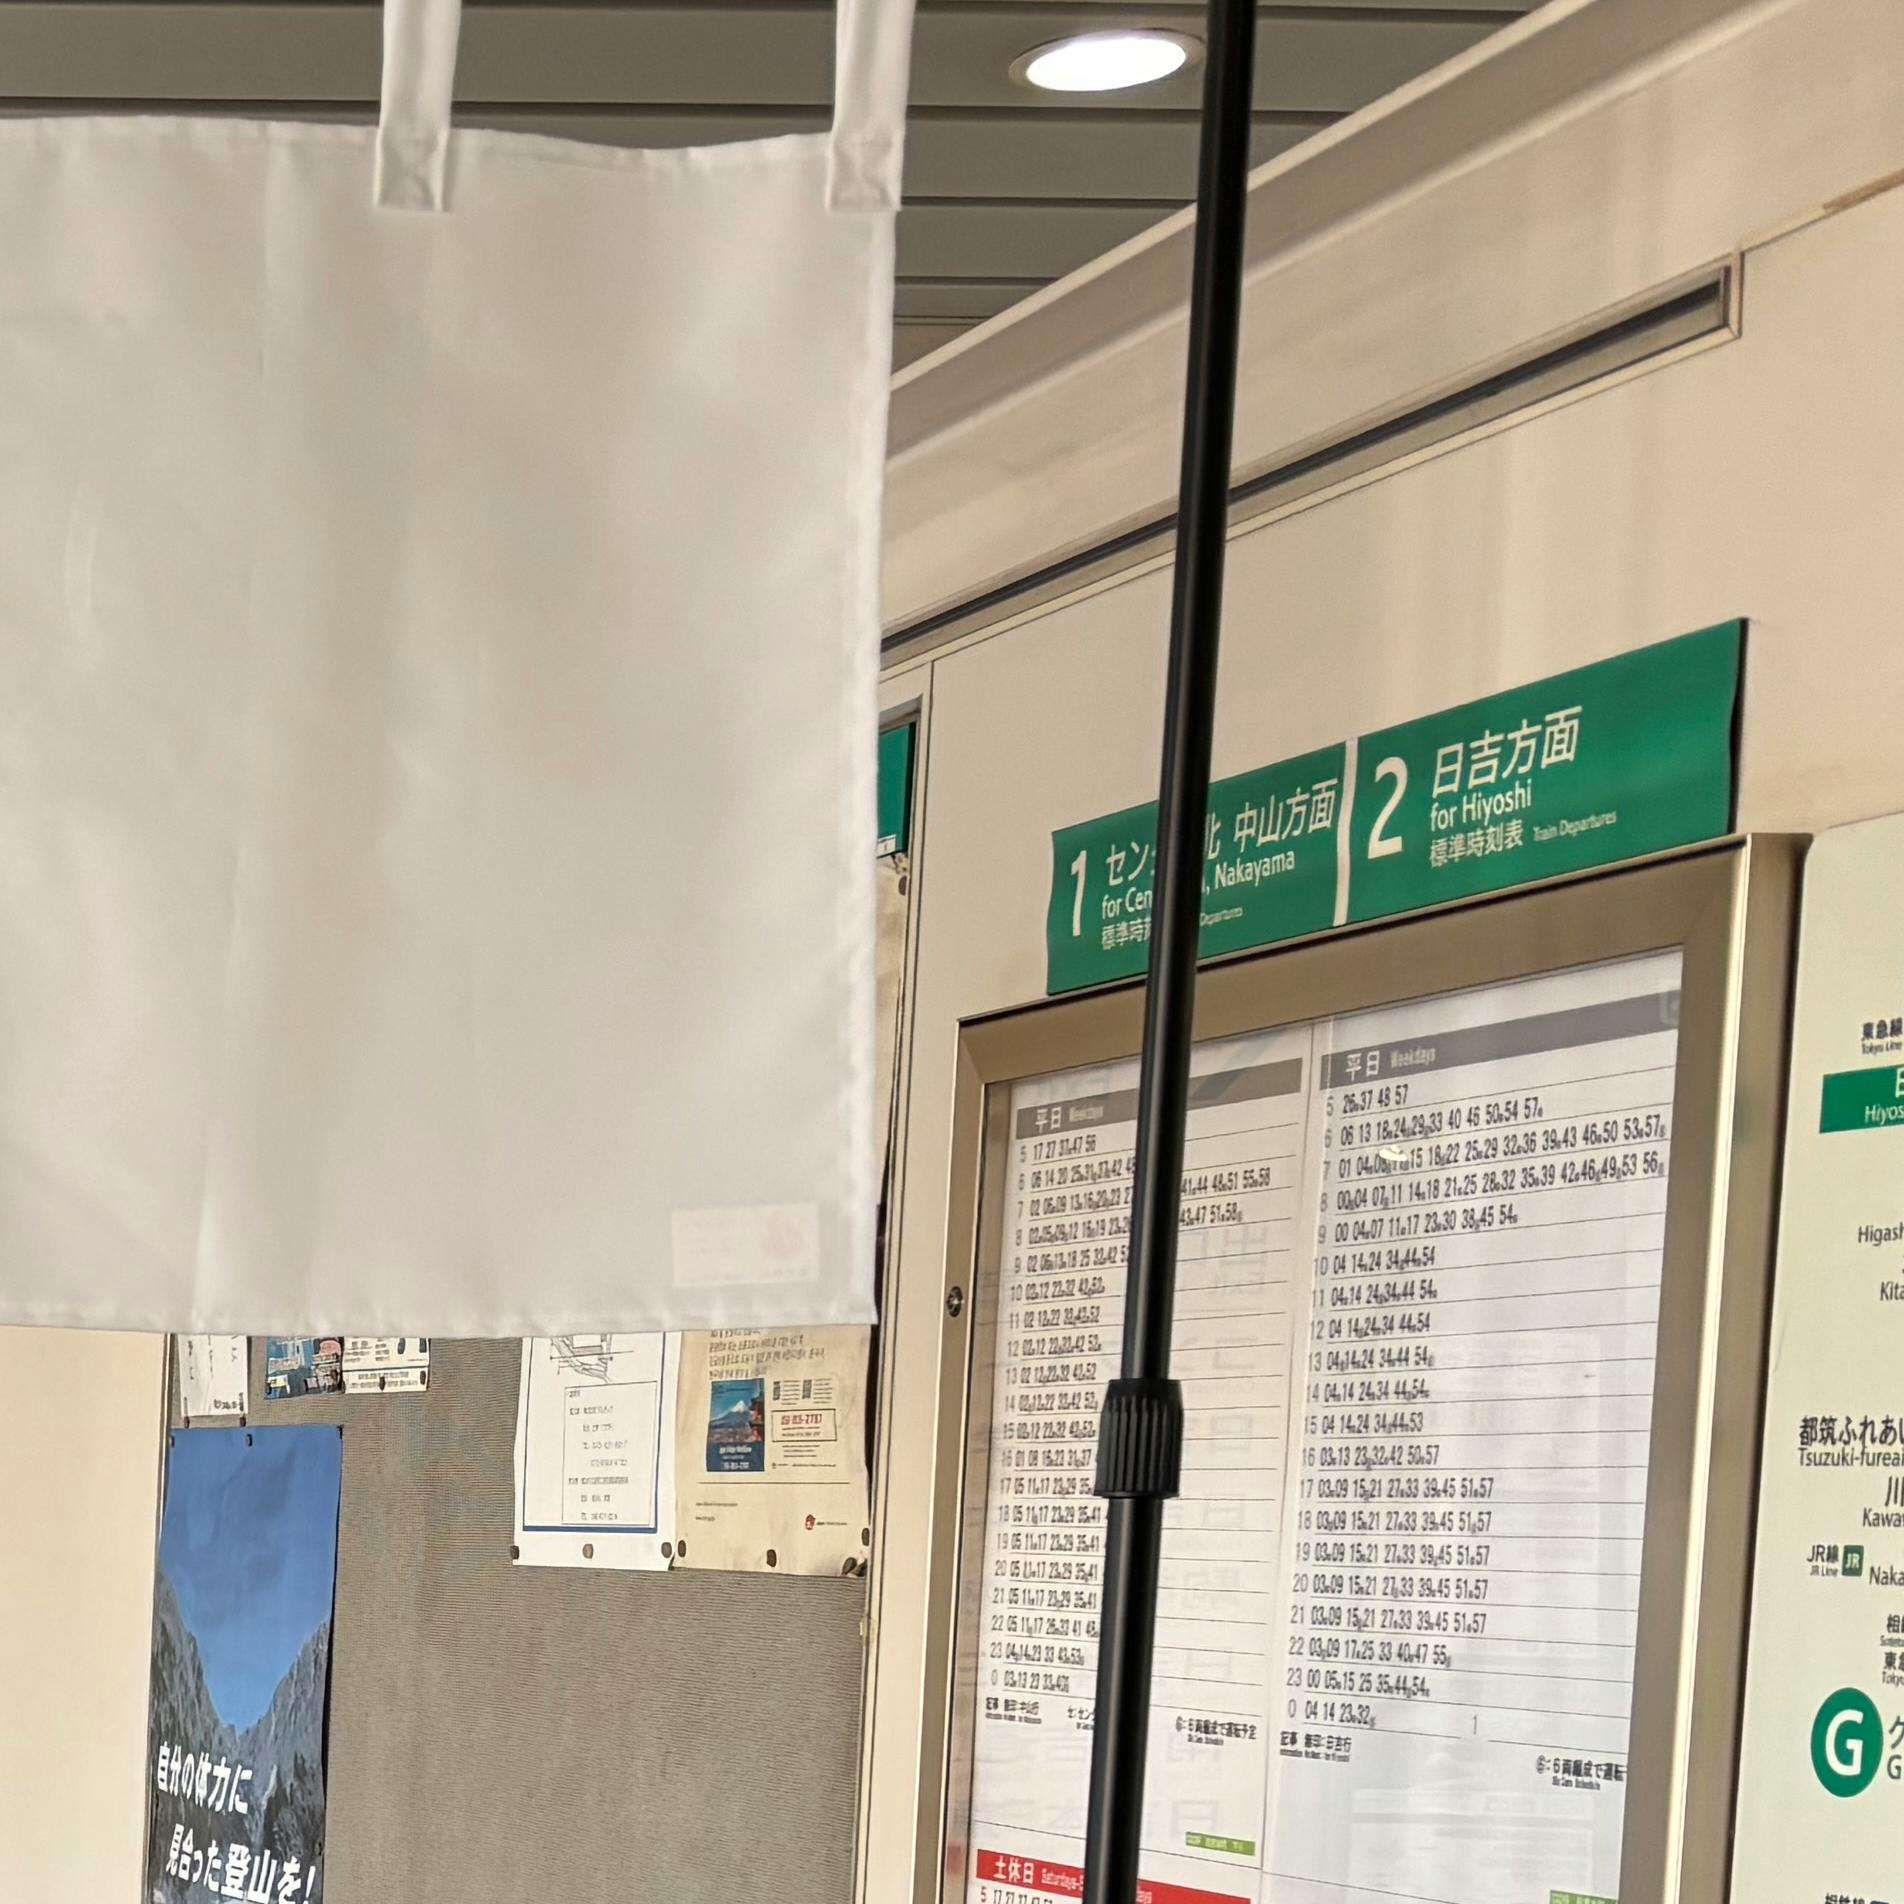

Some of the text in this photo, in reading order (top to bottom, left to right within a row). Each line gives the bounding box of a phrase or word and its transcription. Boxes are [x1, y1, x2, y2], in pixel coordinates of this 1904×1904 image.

[1432, 705, 1583, 802] 日吉方面
[1234, 780, 1338, 853] 中山方面
[1367, 756, 1409, 860] 2
[1430, 781, 1533, 831] for Hiyoshi
[1428, 819, 1524, 869] 標準時刻表
[1071, 850, 1087, 936] 1
[1102, 851, 1295, 919] for Nakayama
[1345, 1050, 1381, 1082] 平日
[1035, 1106, 1062, 1133] 平日
[1807, 1545, 1839, 1564] JR線
[1845, 1552, 1861, 1570] JR
[1825, 1709, 1864, 1777] G
[157, 1741, 254, 1816] 自分の体力に
[994, 1857, 1035, 1884] 土休日
